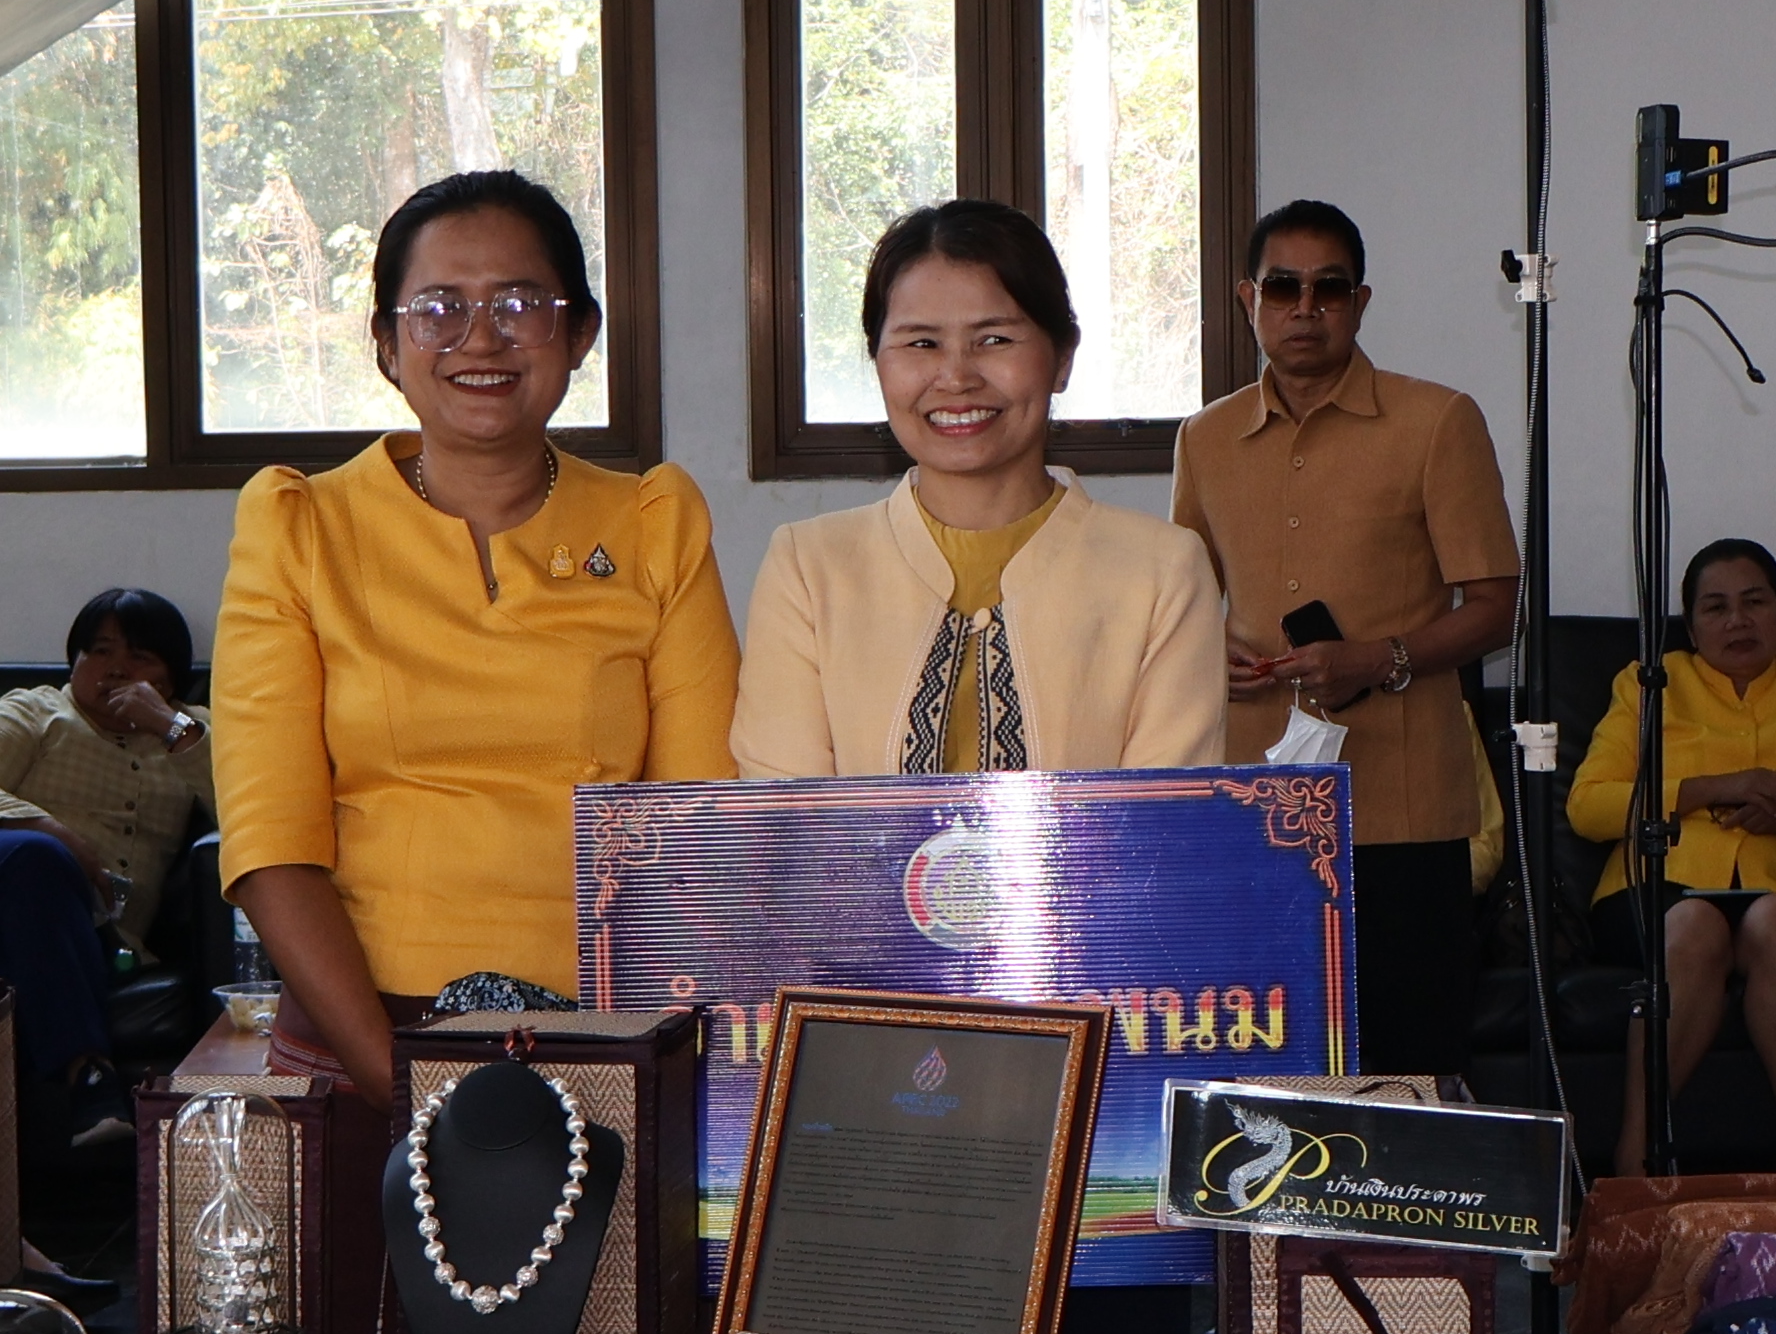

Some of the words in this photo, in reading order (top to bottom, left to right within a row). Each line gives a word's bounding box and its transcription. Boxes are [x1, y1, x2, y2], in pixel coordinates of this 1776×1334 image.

[1325, 1174, 1487, 1207] บ้านเงินประดาพร
[1280, 1193, 1445, 1228] PRADAPRON
[1454, 1210, 1540, 1236] SILVER
